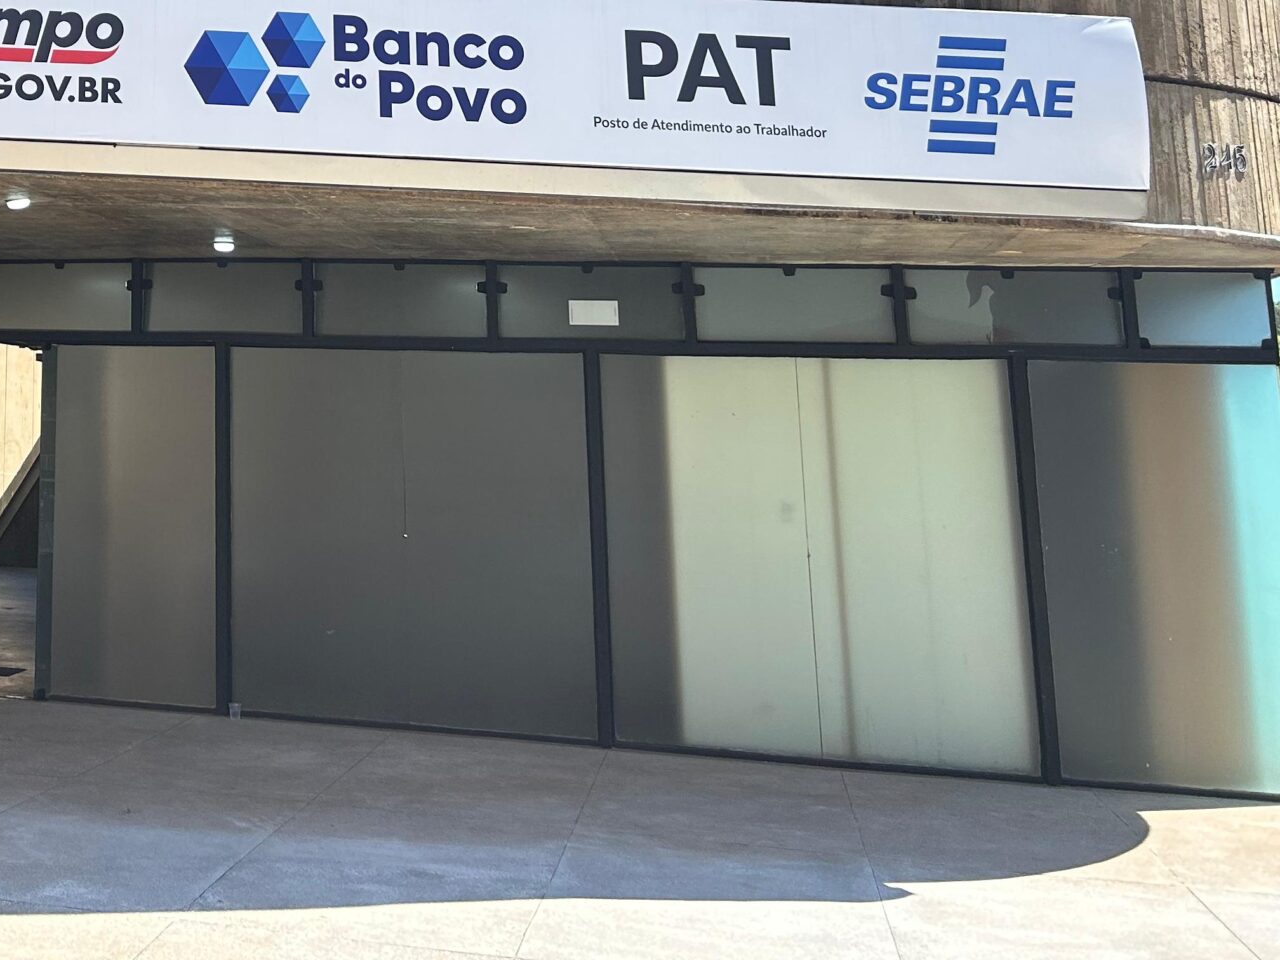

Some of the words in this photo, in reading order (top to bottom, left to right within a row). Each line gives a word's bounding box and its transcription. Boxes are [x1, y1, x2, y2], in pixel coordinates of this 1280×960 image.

[333, 14, 524, 70] Banco
[625, 30, 791, 107] PAT
[334, 68, 367, 89] do
[378, 70, 527, 125] Povo
[864, 72, 1076, 118] SEBRAE
[593, 116, 629, 129] Posto
[633, 118, 648, 130] de
[651, 119, 732, 134] Atendimento
[736, 125, 751, 134] ao
[754, 124, 827, 138] Trabalhador
